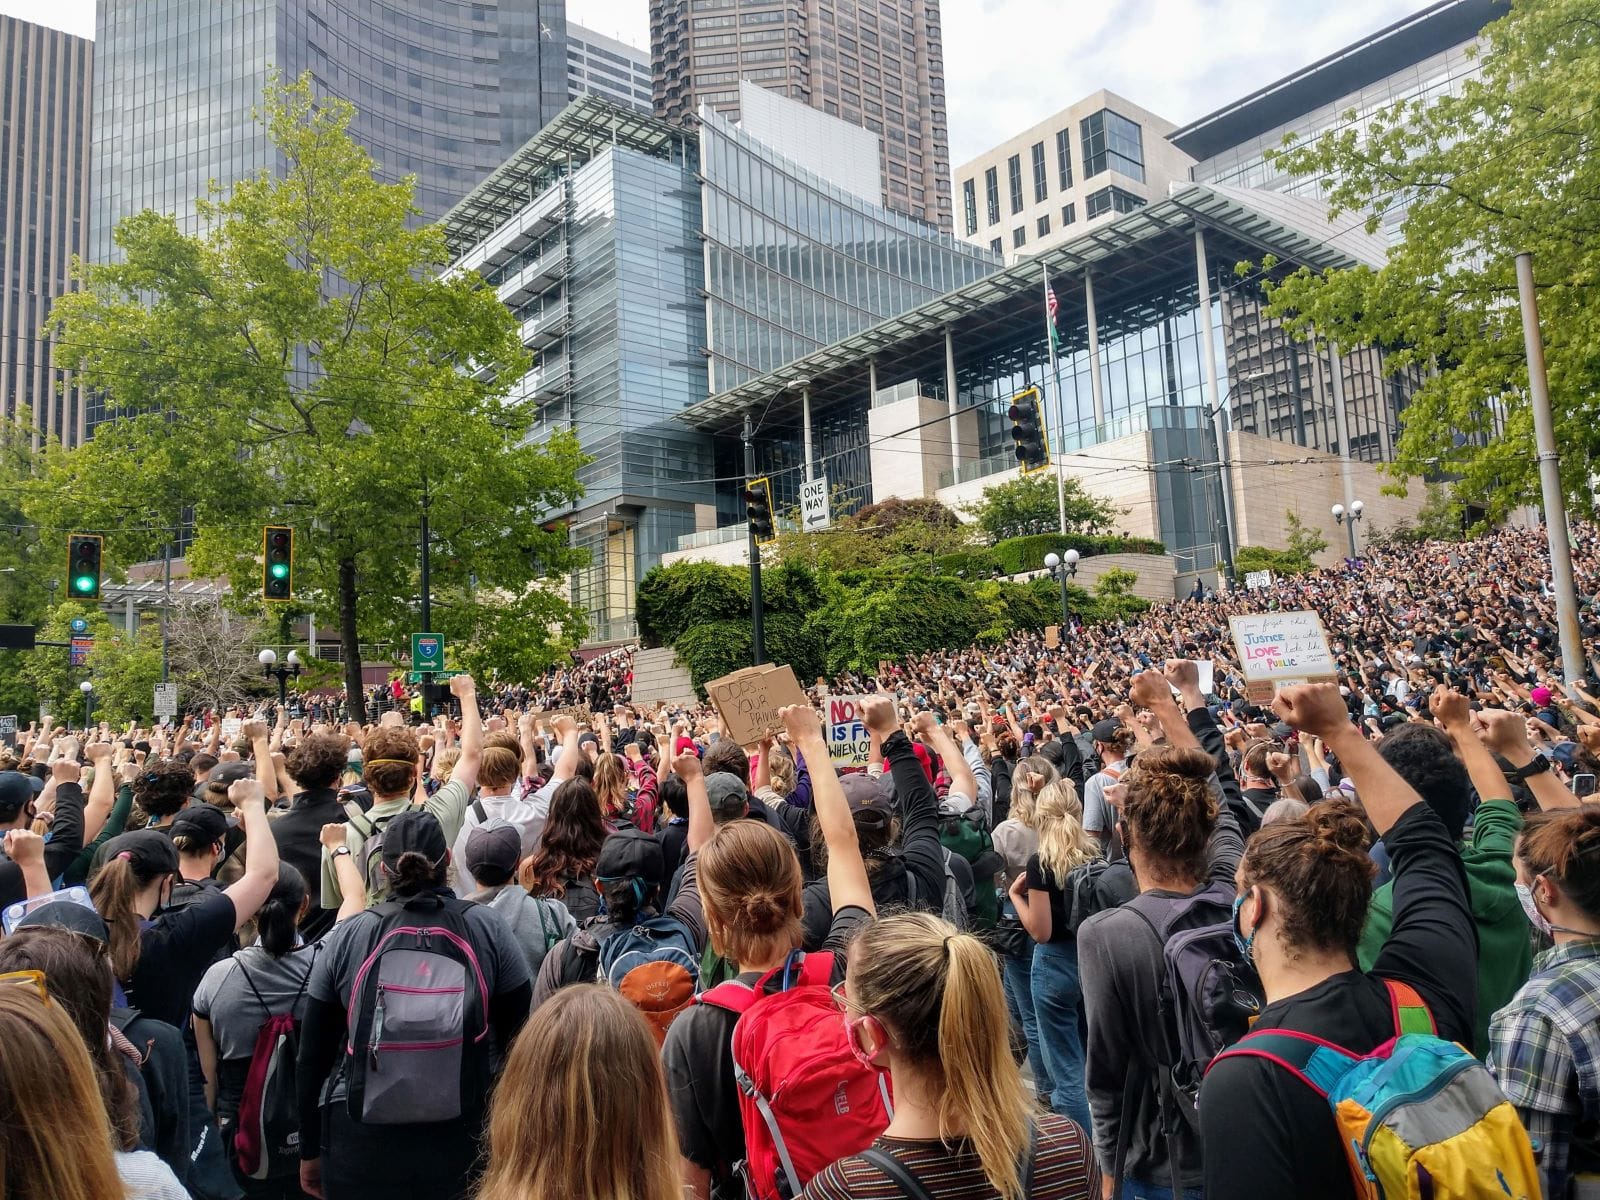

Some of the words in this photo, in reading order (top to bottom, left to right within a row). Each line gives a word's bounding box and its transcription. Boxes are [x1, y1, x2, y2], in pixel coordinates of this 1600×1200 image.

[804, 483, 823, 498] ONE
[805, 496, 824, 511] WAY
[1250, 579, 1267, 587] SPD
[1262, 619, 1285, 632] forget
[1244, 633, 1285, 645] JUSTICE
[1302, 630, 1321, 639] what
[426, 646, 432, 654] 5
[1245, 645, 1282, 660] LOVE
[732, 694, 769, 715] YOUR
[831, 699, 855, 725] NO
[832, 726, 846, 742] IS
[828, 742, 857, 758] WHEN
[852, 754, 869, 764] ARE
